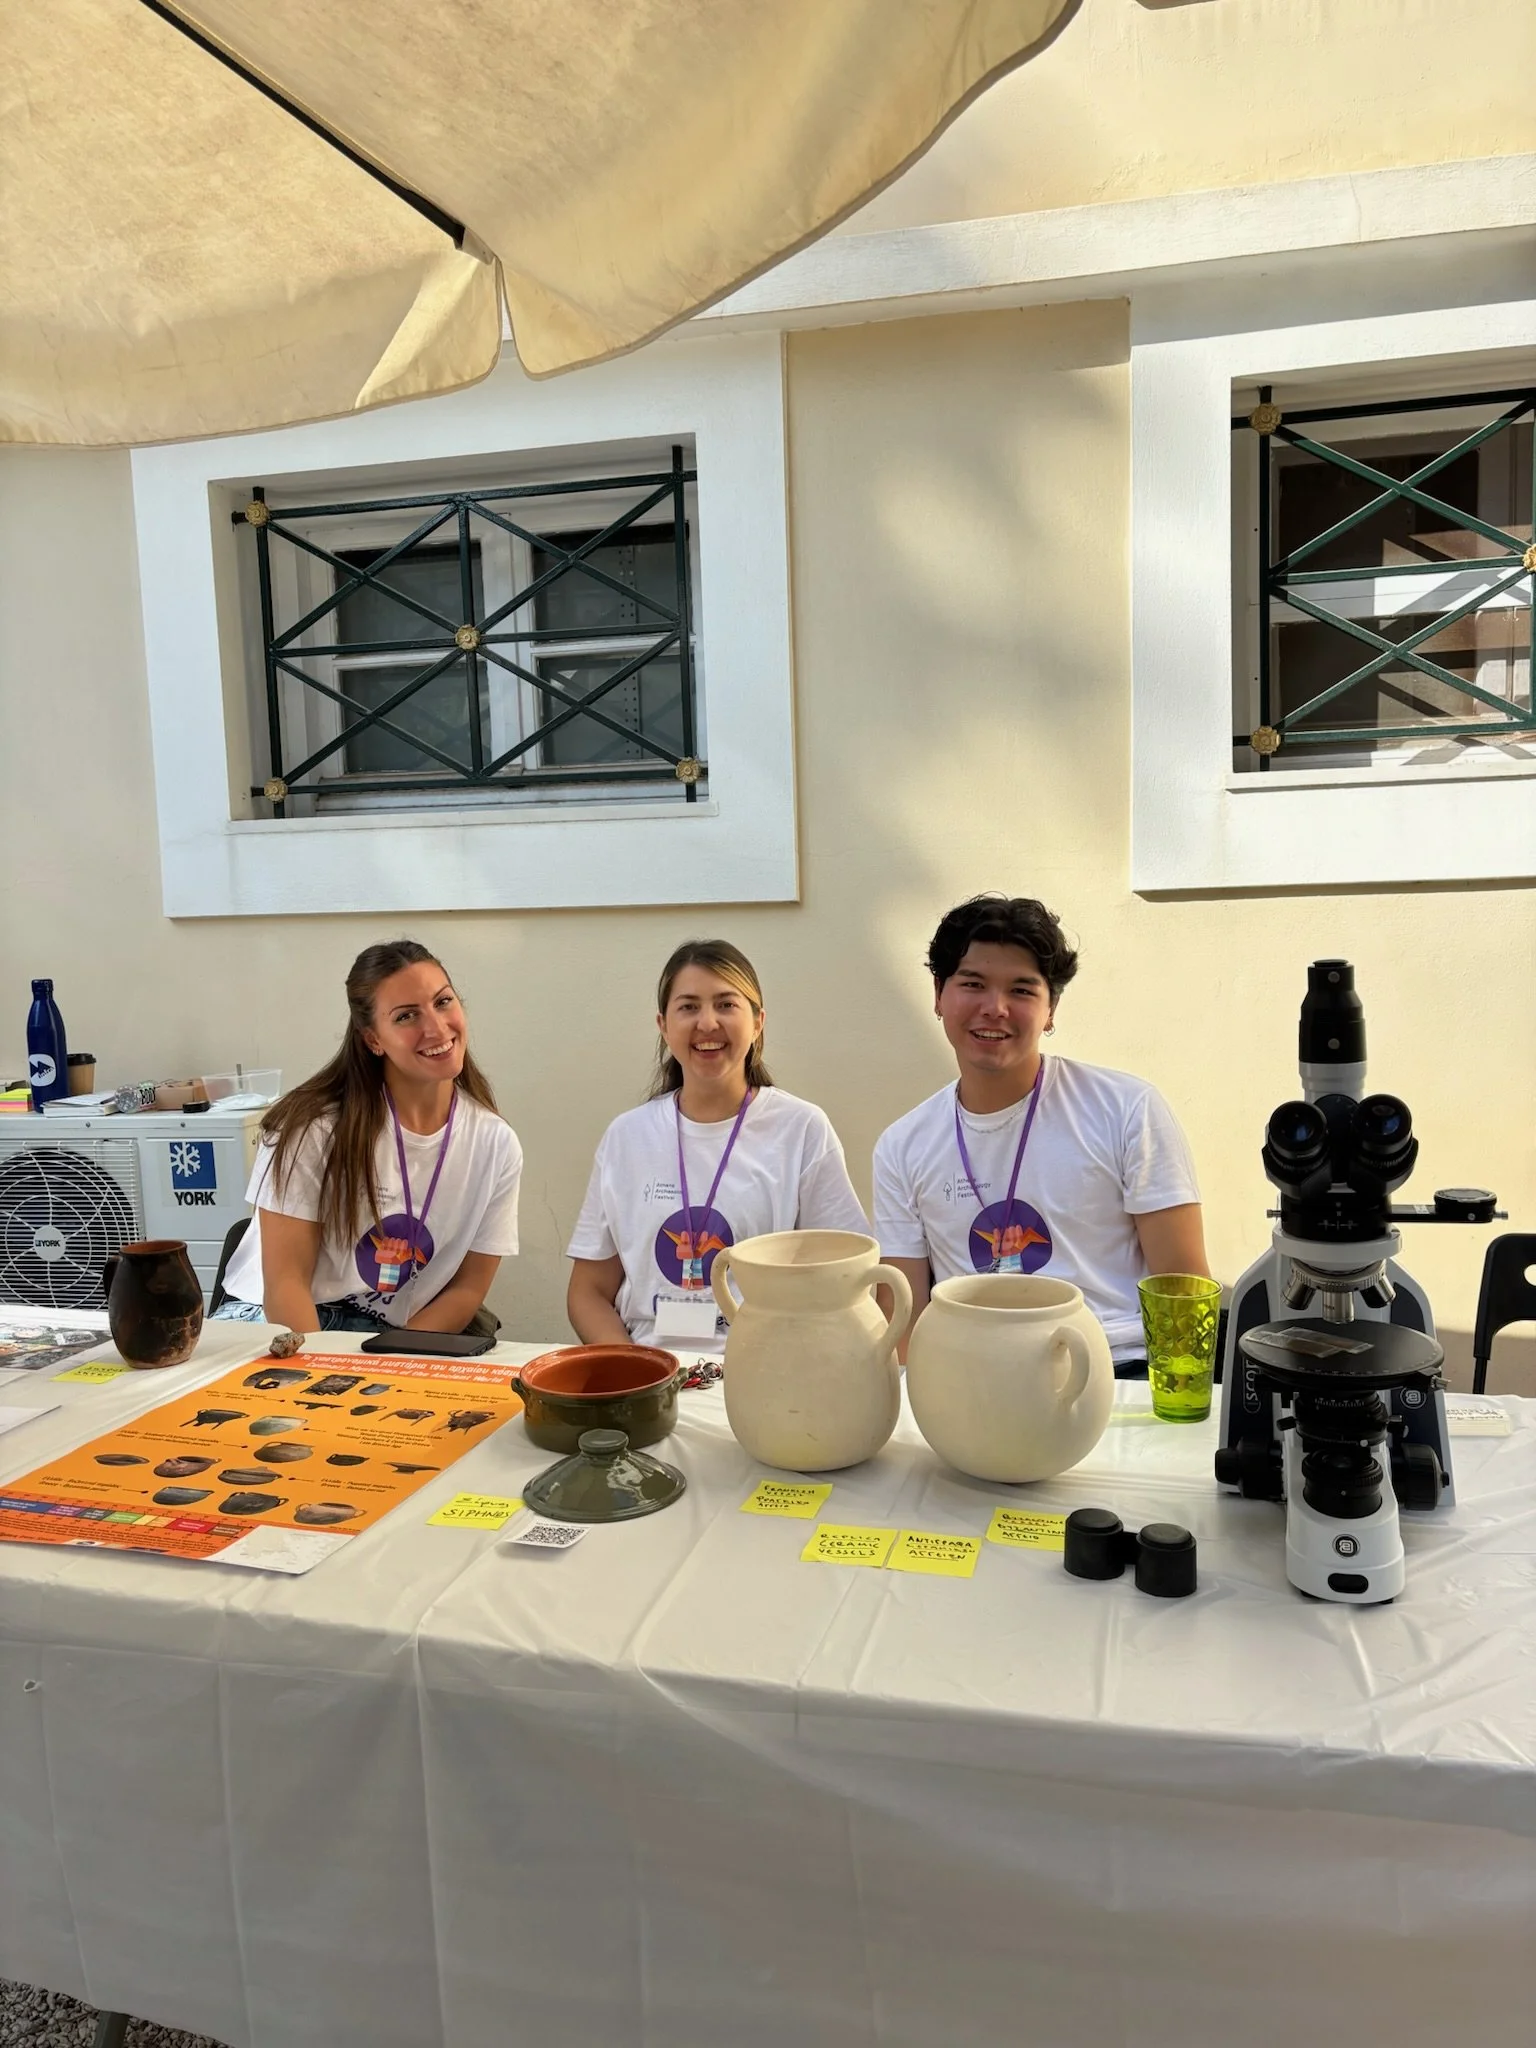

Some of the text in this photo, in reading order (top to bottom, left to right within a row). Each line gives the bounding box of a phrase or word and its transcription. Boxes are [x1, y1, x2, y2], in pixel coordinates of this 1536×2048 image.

[174, 1191, 217, 1207] YORK
[41, 1240, 61, 1248] YORK
[442, 1508, 511, 1519] SIPHNOS
[819, 1540, 880, 1549] CERAMIC
[818, 1548, 877, 1557] VESSELS
